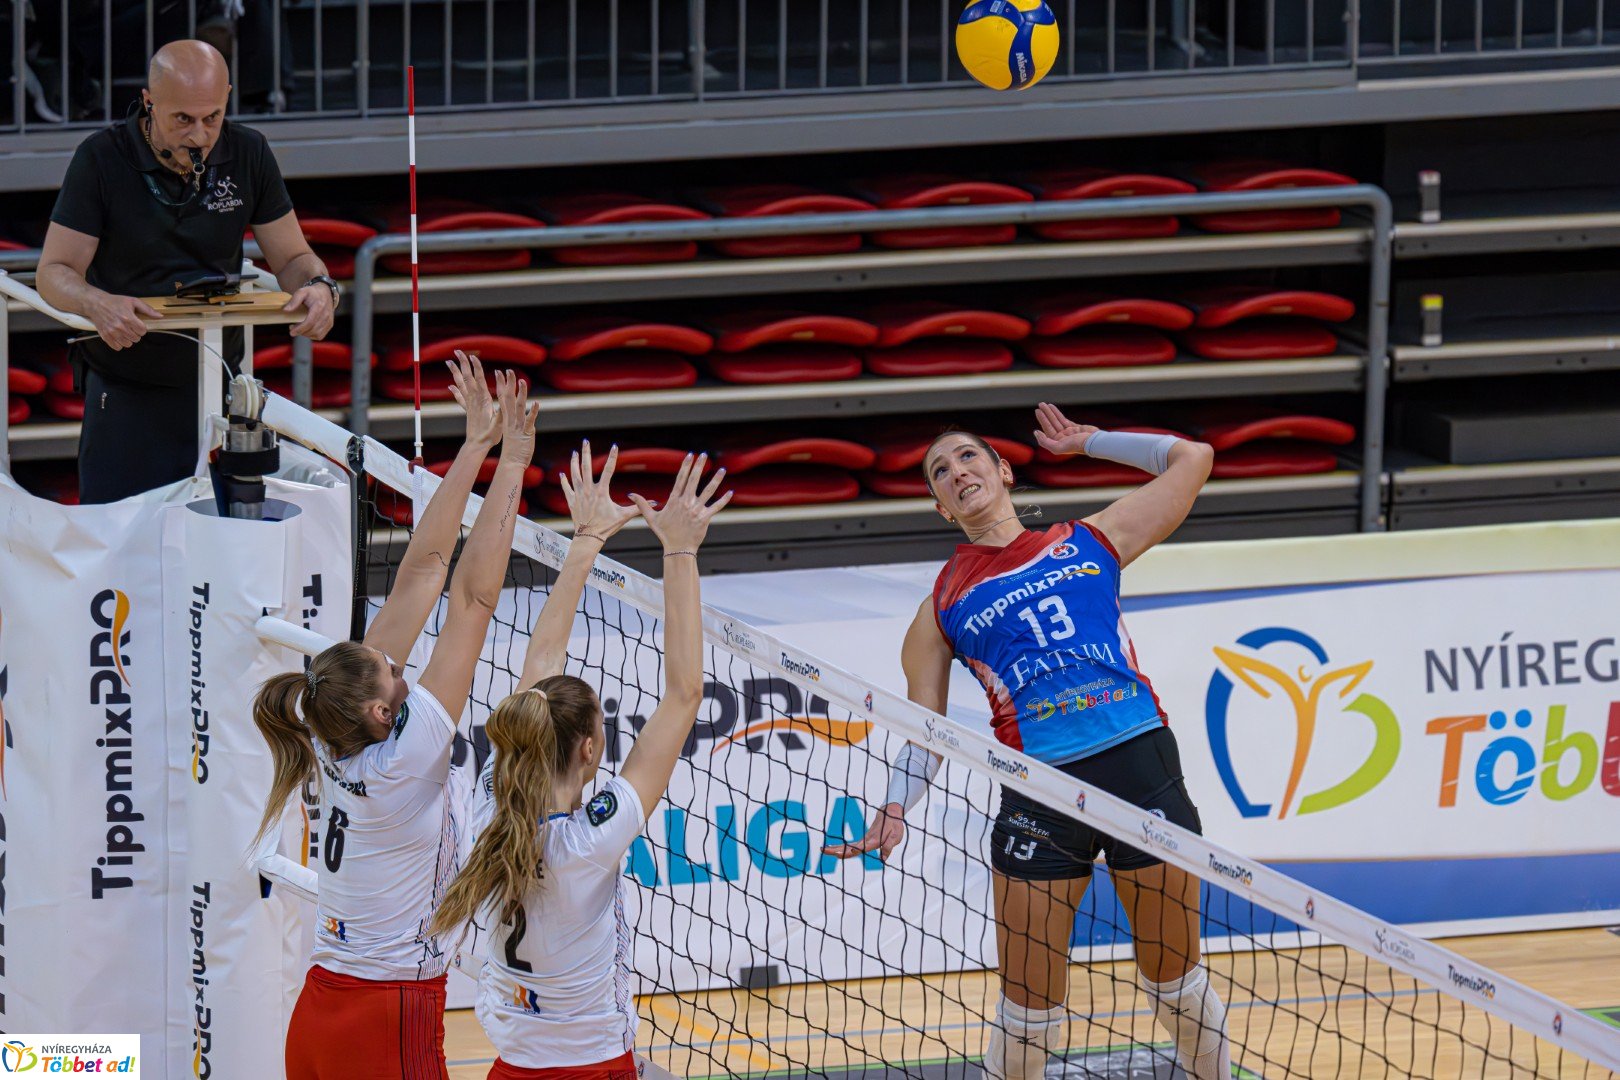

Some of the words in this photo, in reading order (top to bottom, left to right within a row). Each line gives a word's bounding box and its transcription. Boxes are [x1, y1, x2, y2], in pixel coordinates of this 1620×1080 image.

[963, 561, 1101, 636] TippmixPRO
[1017, 595, 1076, 648] 13
[189, 582, 211, 785] TippmixPRO
[781, 651, 821, 682] TippmixPRO
[1008, 642, 1118, 692] FATUM
[1056, 690, 1111, 716] Többet
[89, 588, 146, 900] TippmixPRO
[325, 805, 350, 874] 6
[1004, 835, 1038, 861] 13
[501, 899, 533, 974] 2
[189, 881, 212, 1080] TippmixPRO
